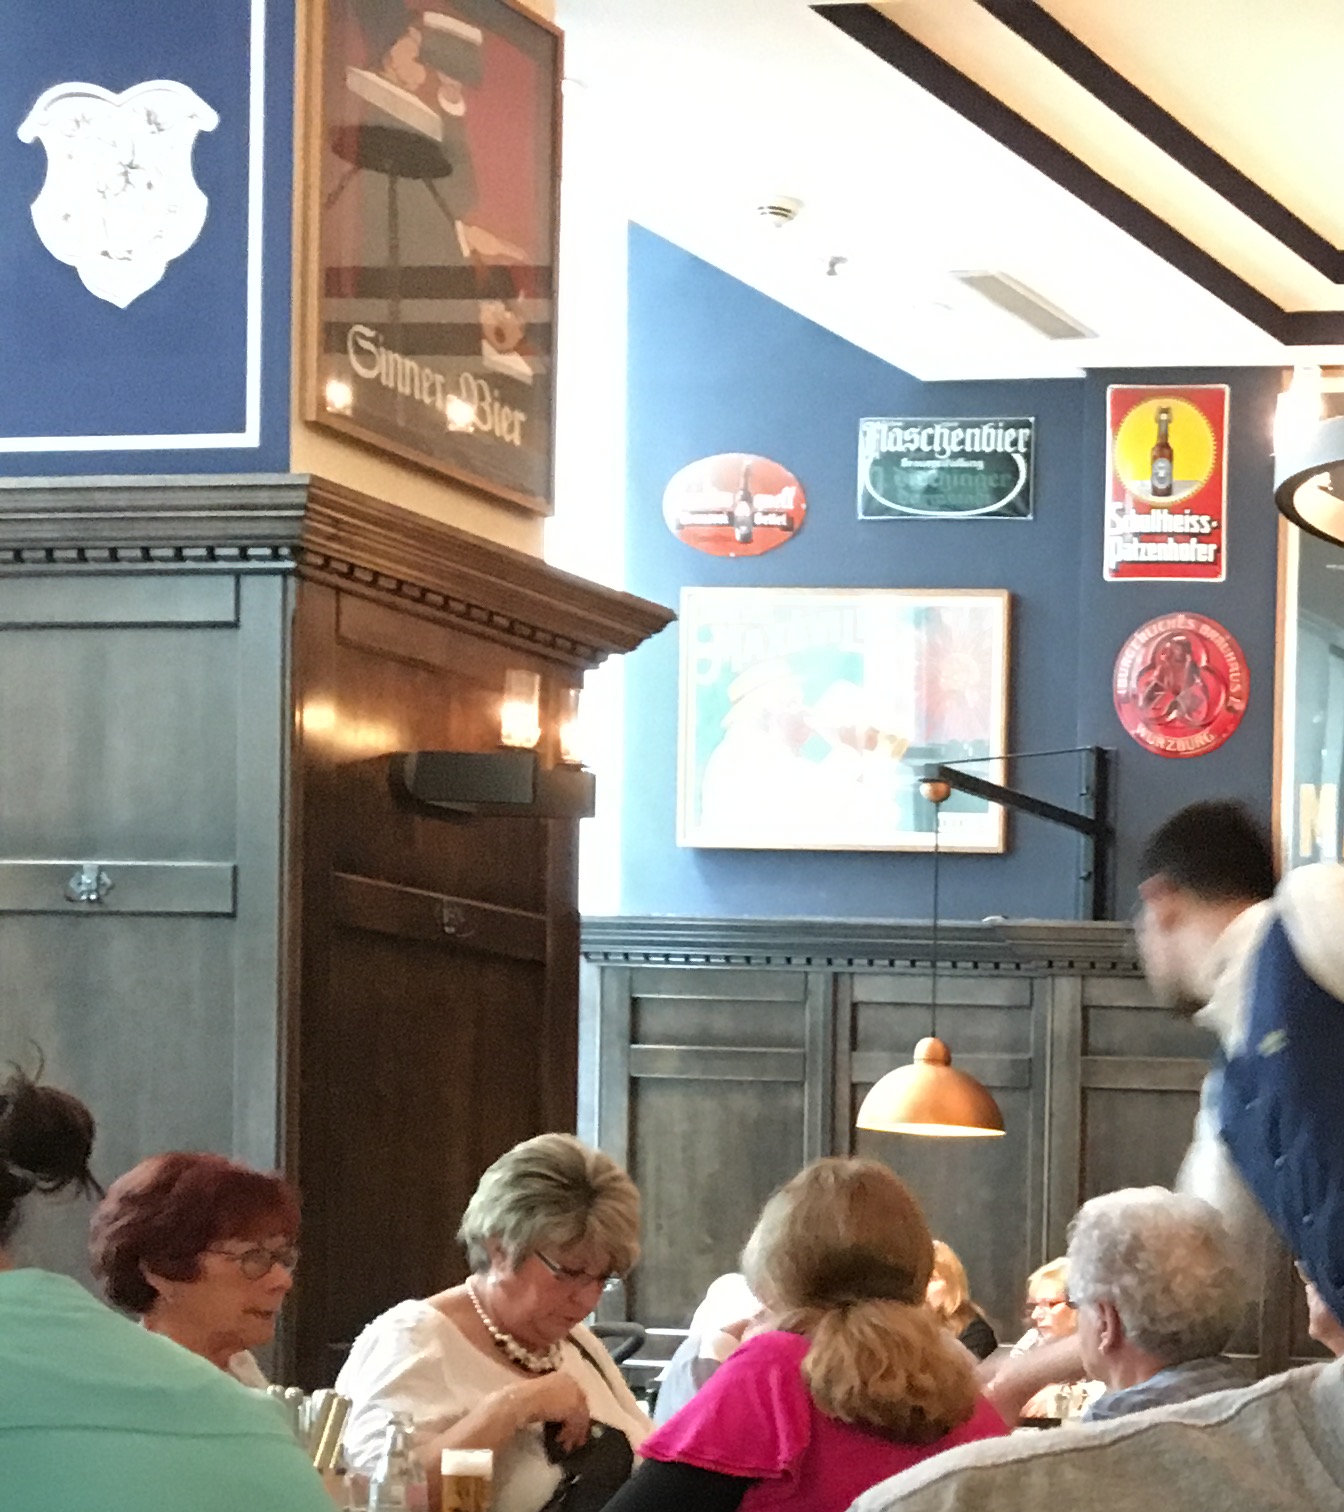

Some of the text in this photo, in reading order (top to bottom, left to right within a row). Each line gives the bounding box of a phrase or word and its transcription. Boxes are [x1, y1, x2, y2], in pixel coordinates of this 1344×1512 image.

[347, 324, 527, 446] Sinner Bier
[862, 421, 1031, 459] Flaschenbier
